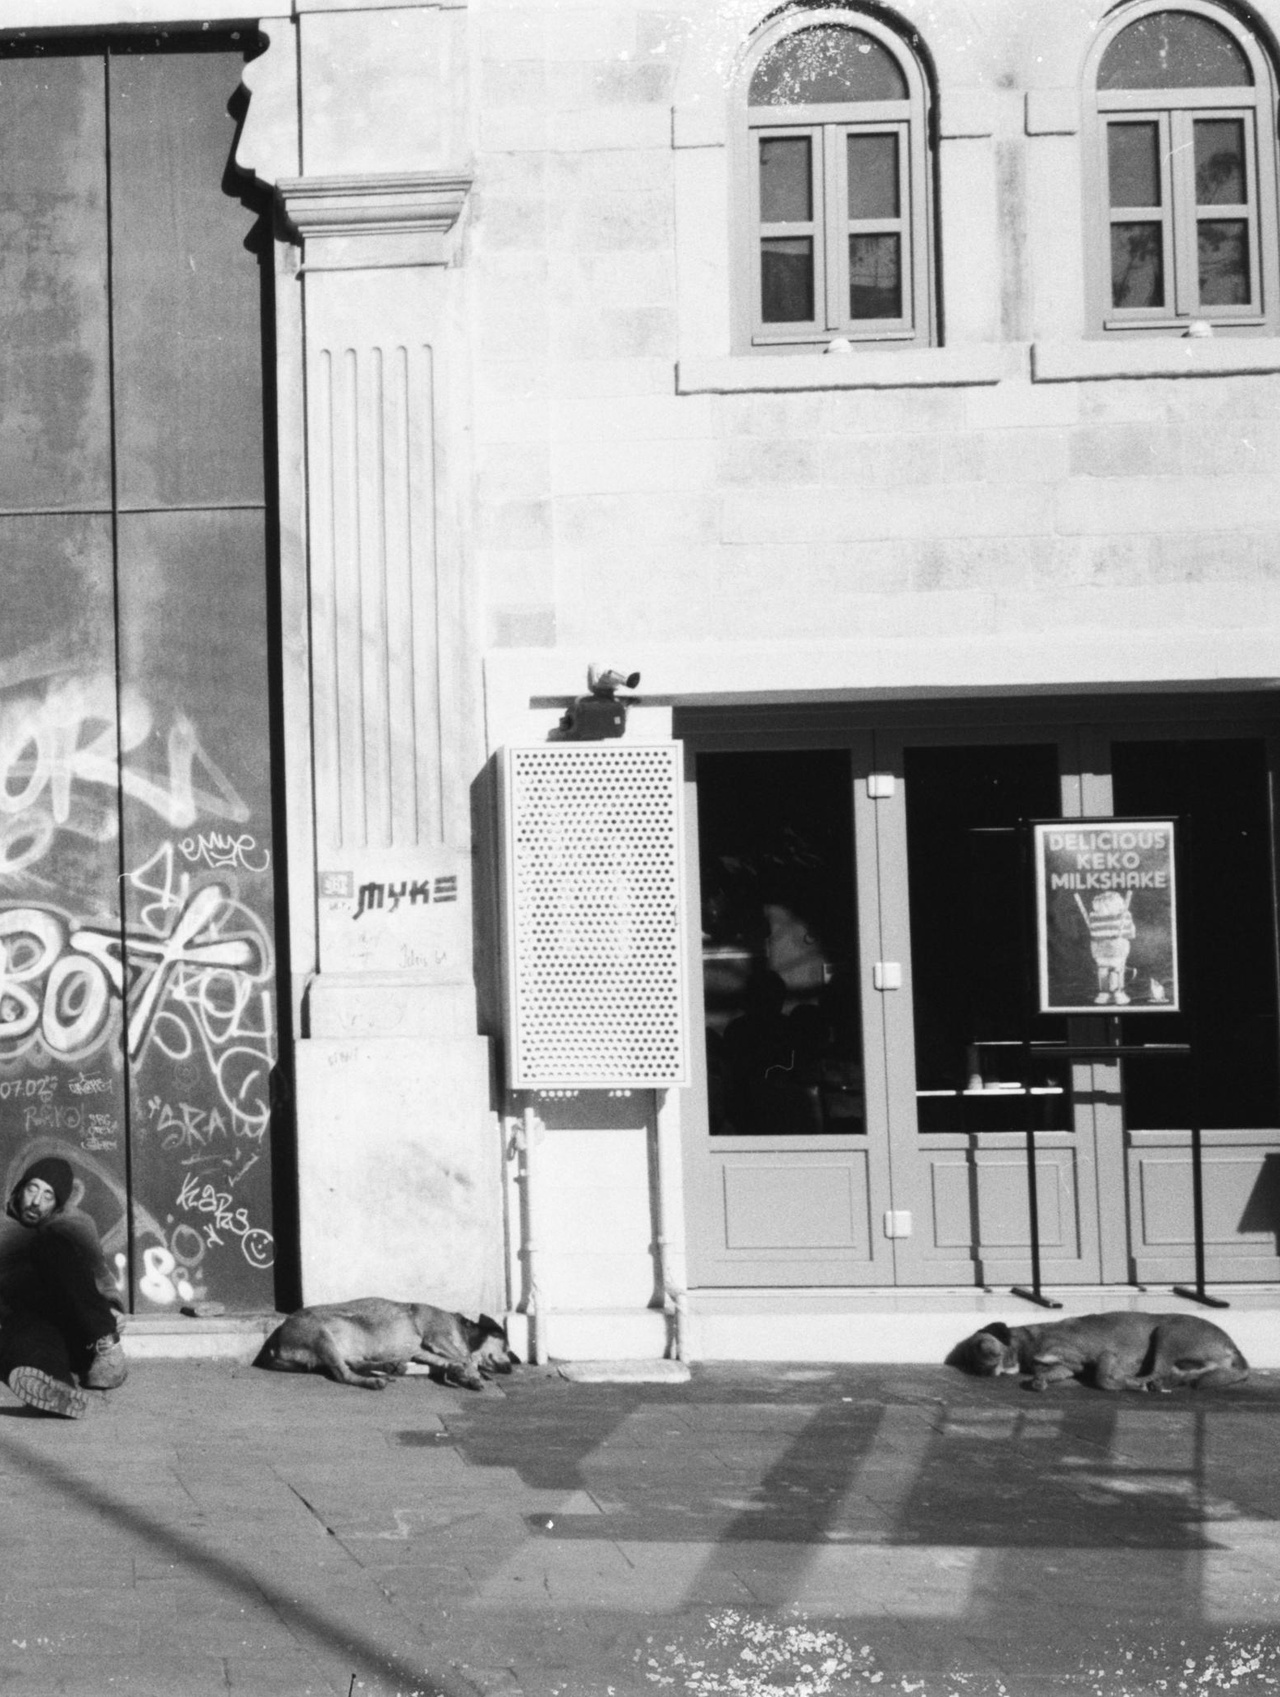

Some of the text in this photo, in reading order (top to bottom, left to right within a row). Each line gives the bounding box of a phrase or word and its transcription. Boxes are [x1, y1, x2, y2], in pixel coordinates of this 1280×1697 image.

[1049, 831, 1166, 851] DELICIOUS
[1077, 851, 1141, 870] KEKO
[1051, 871, 1168, 890] MILKSHAKE
